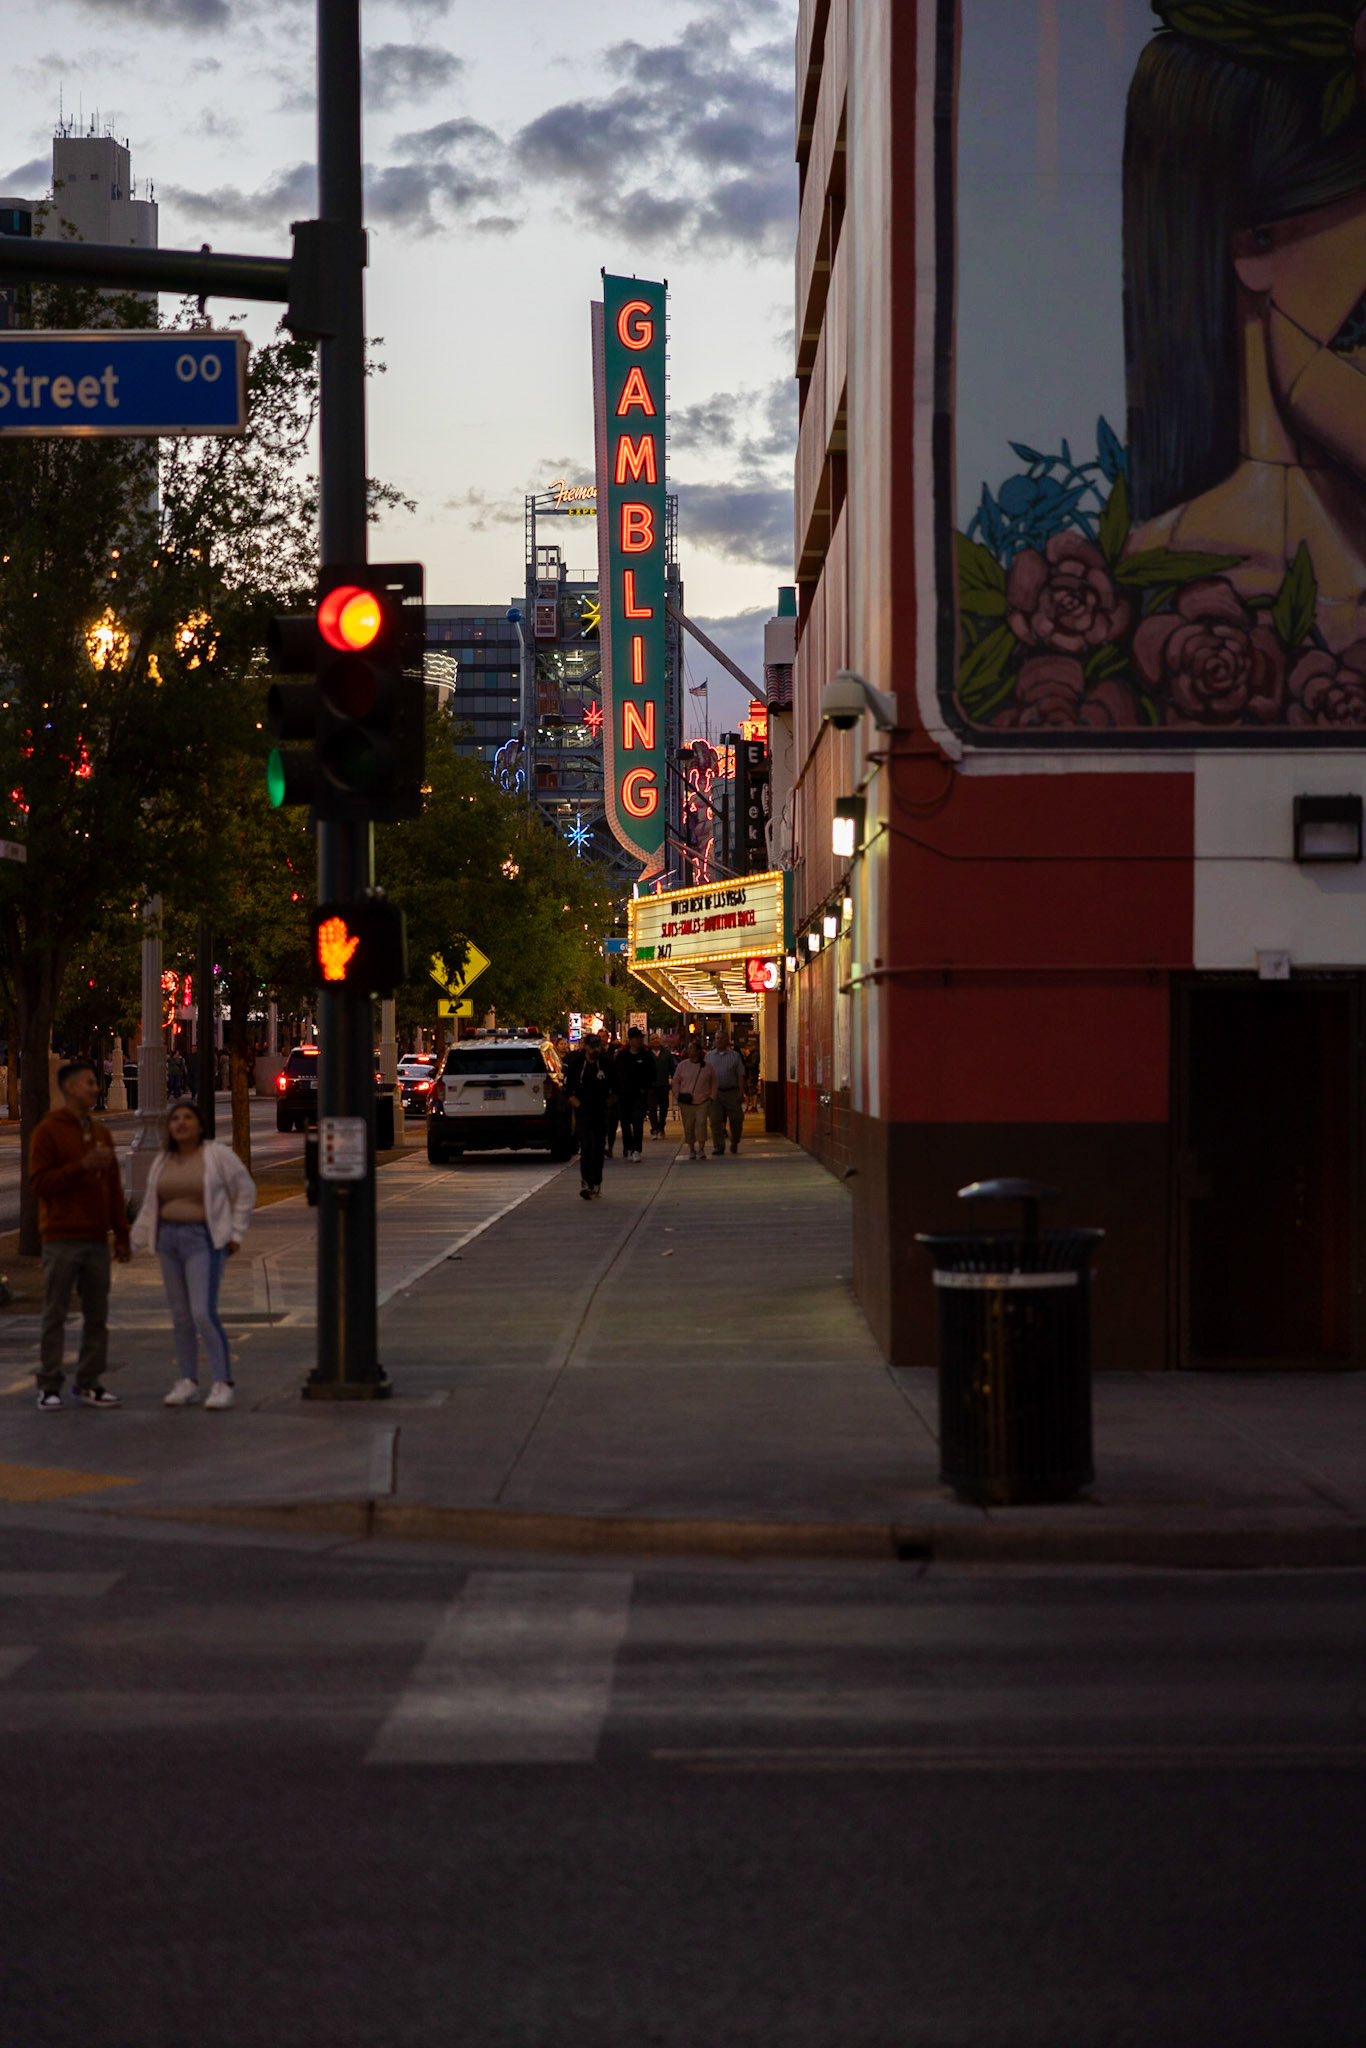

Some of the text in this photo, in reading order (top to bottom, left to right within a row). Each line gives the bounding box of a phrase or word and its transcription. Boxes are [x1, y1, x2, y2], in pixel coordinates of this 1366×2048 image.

[175, 354, 222, 382] 00
[615, 300, 658, 818] GAMBLING
[713, 892, 726, 909] LAS
[727, 888, 747, 907] VEGAS
